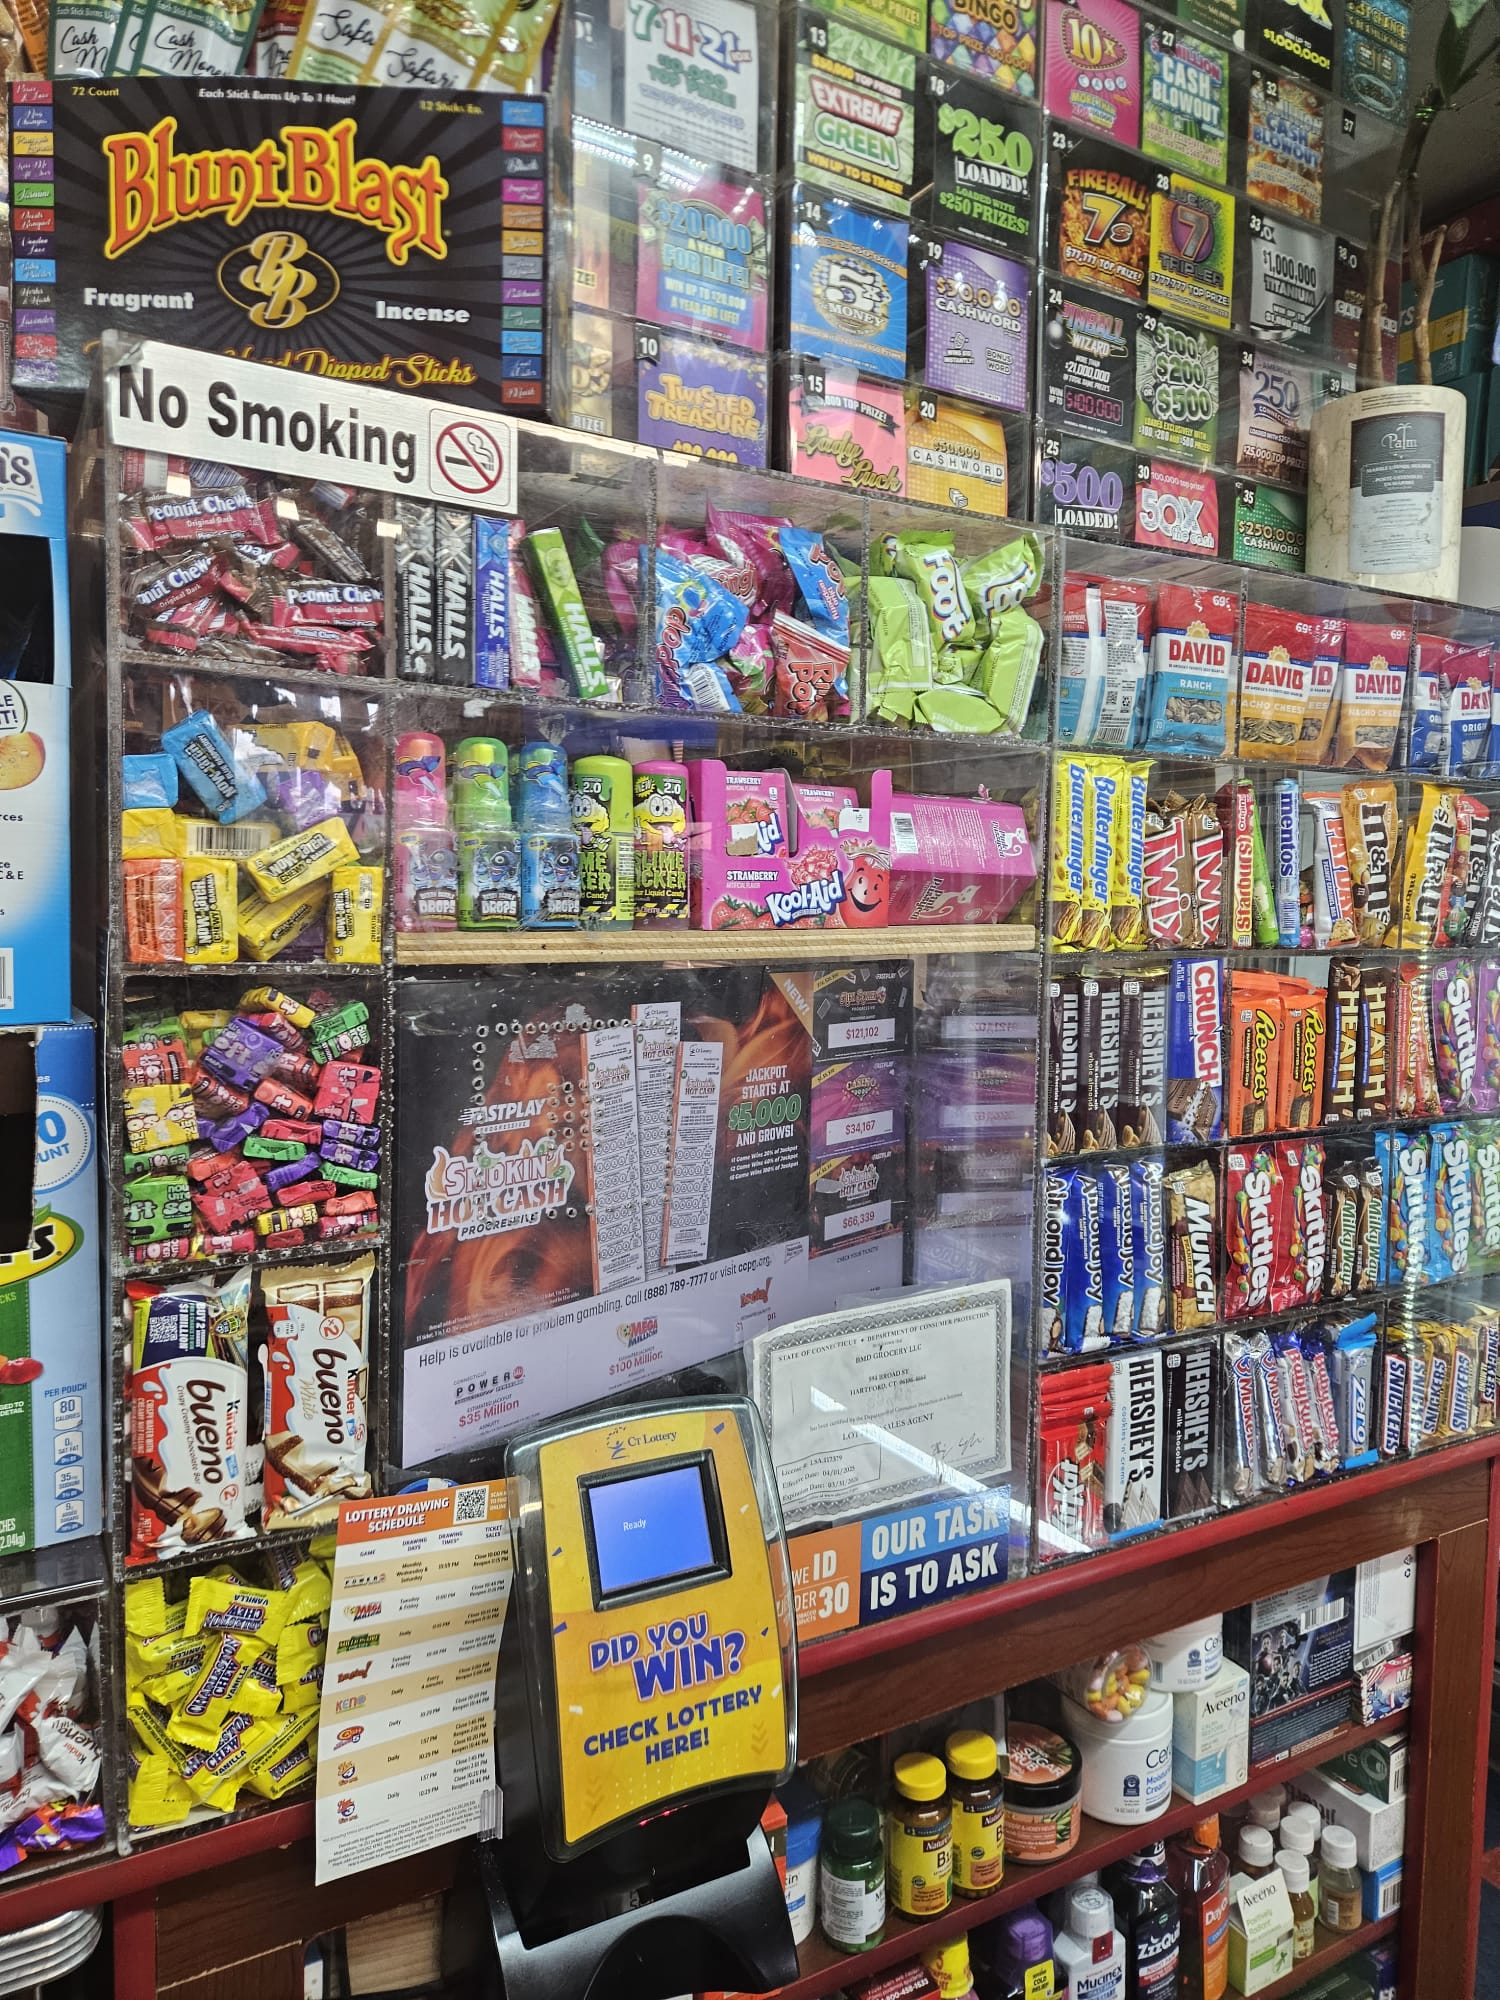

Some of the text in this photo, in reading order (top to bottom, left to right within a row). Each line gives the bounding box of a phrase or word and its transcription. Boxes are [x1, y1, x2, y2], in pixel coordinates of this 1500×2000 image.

[62, 26, 98, 53] Cash
[154, 25, 195, 50] Cash
[810, 26, 826, 47] 13
[1162, 31, 1174, 47] 27
[1263, 28, 1330, 70] $1,000,000!
[72, 87, 119, 97] 72 Count
[199, 88, 223, 98] Each
[227, 89, 250, 99] Stick
[253, 90, 281, 100] Burns
[284, 93, 298, 103] Up
[303, 92, 315, 103] To
[930, 76, 944, 96] 18
[1161, 56, 1212, 101] CASH
[811, 78, 902, 136] EXTREME
[1151, 79, 1221, 126] BLOWOUT
[815, 112, 900, 170] GREEN
[938, 103, 1033, 176] $250
[958, 160, 1029, 195] LOADED!
[1067, 169, 1149, 211] FIREBALL
[1156, 174, 1169, 191] 28
[940, 191, 1030, 236] $250 PRIZES!
[927, 242, 943, 259] 19
[1157, 251, 1225, 290] TRIPLER
[1264, 250, 1318, 288] $1,000,000
[84, 288, 194, 311] Fragrant
[376, 301, 470, 323] Incense
[828, 302, 884, 327] MONEY
[1049, 288, 1062, 305] 24
[1060, 300, 1127, 344] PINBALL
[1144, 313, 1157, 331] 29
[640, 337, 658, 356] 10
[985, 348, 1013, 364] BONUS
[390, 354, 476, 387] Sticks
[808, 374, 823, 393] 15
[987, 361, 1012, 375] WORD
[1156, 352, 1206, 388] $200
[659, 374, 756, 415] TWISTED
[1155, 385, 1214, 421] $500
[1254, 370, 1300, 409] 250
[120, 366, 417, 483] No Smoking
[646, 391, 760, 440] TREASURE
[920, 401, 936, 420] 20
[797, 424, 864, 467] Lady
[1046, 439, 1059, 455] 25
[841, 460, 903, 493] Luck
[1041, 458, 1124, 514] $500
[1137, 465, 1150, 481] 30
[149, 493, 254, 520] Peanut Chews
[1055, 507, 1119, 530] LOADED!
[287, 587, 341, 605] Peanut
[408, 562, 433, 655] HALLS
[443, 568, 467, 660] HALLS
[488, 569, 506, 640] HALLS
[562, 602, 606, 693] HALLS
[1169, 638, 1226, 667] DAVID
[1180, 678, 1213, 691] RANCH
[1245, 661, 1304, 690] DAVID
[1355, 673, 1401, 695] DAVID
[583, 780, 602, 795] 2.0
[664, 780, 682, 795] 2.0
[1089, 776, 1116, 904] Butterfinger
[1279, 792, 1296, 877] mentos
[280, 861, 308, 884] CHEWY
[727, 870, 778, 882] STRAWBERRY
[1144, 818, 1186, 943] TWIX
[1324, 817, 1354, 921] PAYDAY
[481, 899, 518, 914] DROPS
[766, 869, 846, 927] Kool-Aid
[1403, 873, 1416, 921] peanut
[783, 978, 810, 1016] NEW!
[846, 1027, 879, 1041] $121,102
[1194, 966, 1219, 1082] CRUNCH
[1100, 991, 1121, 1110] HERSHEY'S
[1141, 990, 1166, 1107] HERSHEY'S
[1253, 1009, 1276, 1101] Reese's
[1302, 1008, 1325, 1095] Reese's
[1332, 991, 1360, 1104] HEATH
[1364, 986, 1387, 1099] HEATH
[742, 1081, 791, 1099] STARTS AT
[746, 1065, 787, 1082] JACKPOT
[471, 1098, 548, 1124] FASTPLAY
[728, 1094, 802, 1131] $5,000
[845, 1119, 876, 1135] $34,167
[736, 1124, 794, 1148] AND GROWS!
[429, 1180, 566, 1231] HOT CASH
[842, 1211, 875, 1229] $66,339
[1444, 1140, 1471, 1272] Skittles
[1245, 1171, 1274, 1307] Skittles
[1301, 1165, 1326, 1294] Skittles
[1185, 1196, 1216, 1312] MUNCH
[419, 1351, 446, 1368] Help
[450, 1346, 459, 1359] is
[462, 1331, 513, 1354] available
[515, 1327, 530, 1339] for
[532, 1311, 574, 1335] problem
[576, 1299, 623, 1324] gambling.
[625, 1291, 643, 1305] Call
[643, 1283, 668, 1302] (888)
[669, 1272, 708, 1293] 789-7777
[710, 1271, 719, 1281] or
[719, 1264, 737, 1277] visit
[608, 1358, 633, 1376] $100
[873, 1346, 908, 1360] GROCERY
[909, 1343, 922, 1353] LLC
[44, 1383, 88, 1398] PER POUCH
[60, 1399, 75, 1412] 80
[313, 1348, 347, 1444] bueno
[1388, 1360, 1404, 1452] SNICKERS
[1424, 1359, 1446, 1434] SNICKERS
[1452, 1352, 1470, 1431] SNICKERS
[226, 1400, 241, 1451] Kinder
[458, 1399, 520, 1428] $35 Million
[1129, 1358, 1156, 1483] HERSHEY'S
[1182, 1349, 1211, 1473] HERSHEY'S
[184, 1379, 226, 1485] bueno
[643, 1429, 678, 1446] Lottery
[345, 1497, 450, 1524] LOTTERY DRAWING
[368, 1515, 426, 1534] SCHEDULE
[622, 1517, 648, 1532] Ready
[871, 1501, 1000, 1561] OUR TASK
[813, 1550, 838, 1581] ID
[870, 1542, 999, 1610] IS TO ASK
[818, 1581, 850, 1619] 30
[591, 1613, 709, 1673] DID YOU
[213, 1659, 241, 1697] CHEW
[225, 1666, 250, 1700] VANILLA
[631, 1631, 745, 1702] WIN?
[583, 1684, 763, 1757] CHECK LOTTERY
[1202, 1690, 1247, 1718] Aveeno
[206, 1735, 241, 1771] CHEW
[212, 1750, 247, 1776] VANILLA
[645, 1727, 710, 1765] HERE!
[1022, 1746, 1063, 1776] SUGAR
[1242, 1882, 1278, 1910] Aveeno
[1077, 1964, 1123, 1994] Mucinex
